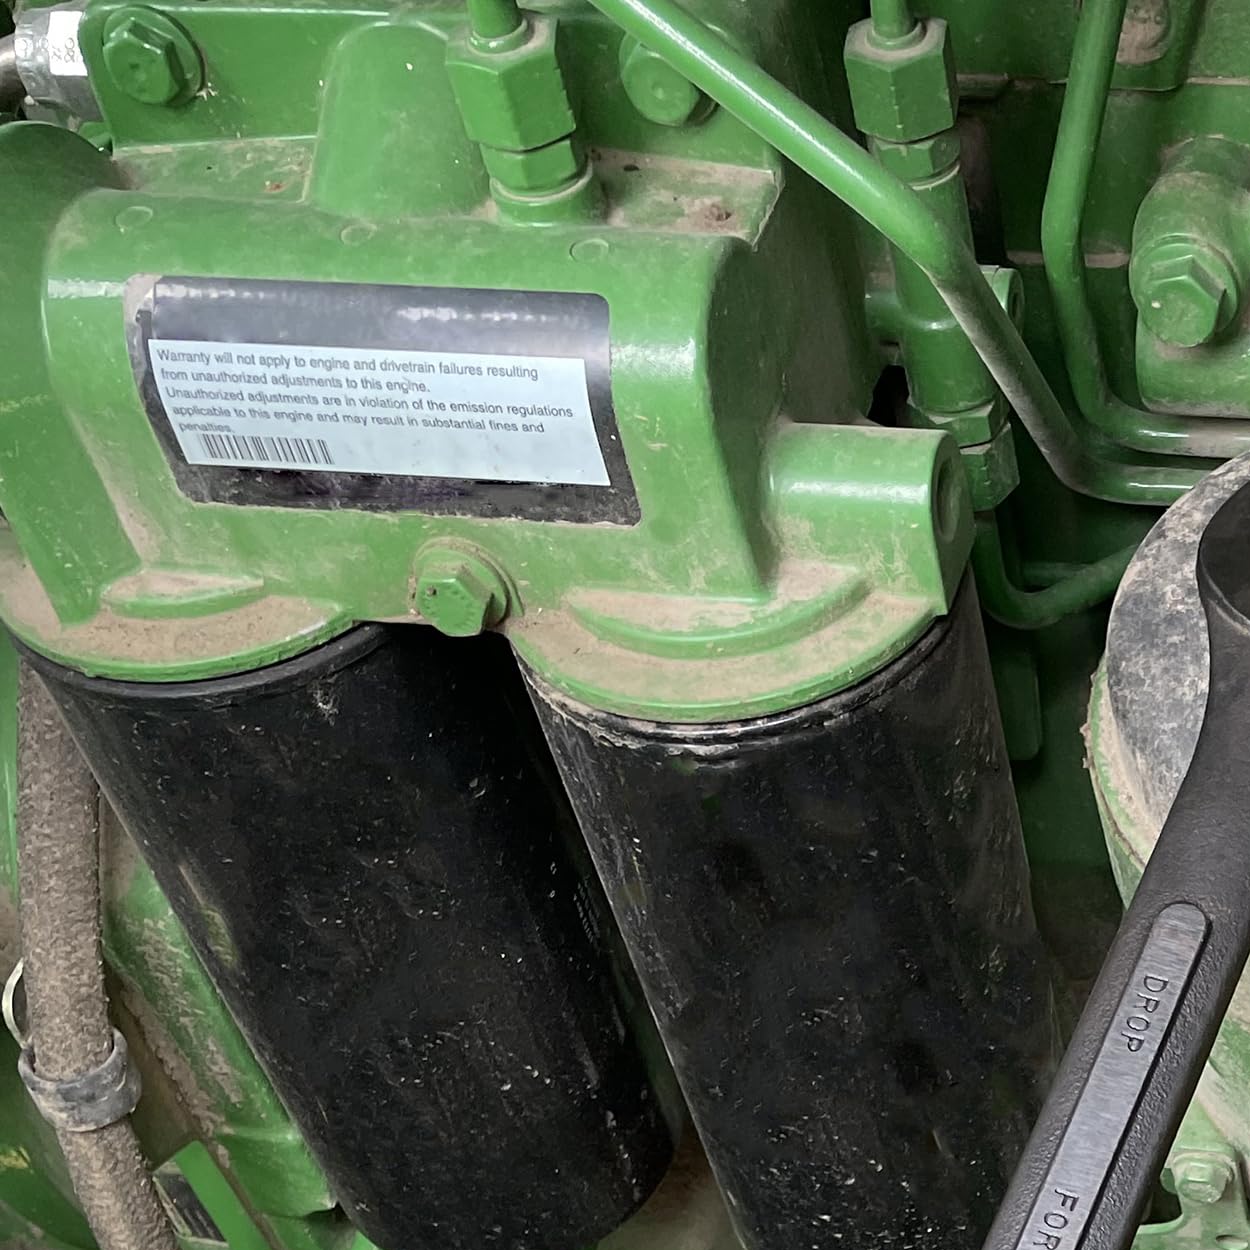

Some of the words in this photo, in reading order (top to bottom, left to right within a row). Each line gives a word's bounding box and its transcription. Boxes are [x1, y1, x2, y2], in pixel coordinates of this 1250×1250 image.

[158, 350, 211, 365] Warranty
[214, 352, 233, 364] will
[237, 354, 255, 365] not
[259, 356, 291, 369] apply
[294, 357, 306, 367] to
[309, 357, 349, 371] engine
[354, 359, 376, 371] and
[380, 360, 435, 374] drivetrain
[439, 362, 483, 376] failures
[487, 365, 538, 381] resulting
[161, 368, 188, 381] from
[192, 370, 267, 385] unauthorized
[271, 373, 342, 388] adjustments
[346, 376, 357, 388] to
[361, 378, 382, 390] this
[386, 379, 430, 394] engine.
[165, 387, 243, 401] Unauthorized
[248, 391, 318, 406] adjustments
[322, 397, 341, 406] are
[345, 394, 356, 406] in
[359, 396, 409, 409] violation
[412, 398, 423, 410] of
[427, 399, 446, 411] the
[450, 401, 503, 414] emission
[507, 402, 573, 418] regulations
[172, 405, 231, 417] applicable
[234, 407, 246, 417] to
[250, 407, 270, 419] this
[274, 409, 313, 423] engine
[317, 410, 339, 422] and
[342, 414, 367, 427] may
[371, 414, 404, 426] result
[407, 415, 418, 426] in
[422, 417, 485, 430] substantial
[489, 418, 518, 432] fines
[522, 421, 545, 433] and
[1121, 974, 1169, 1055] DROP
